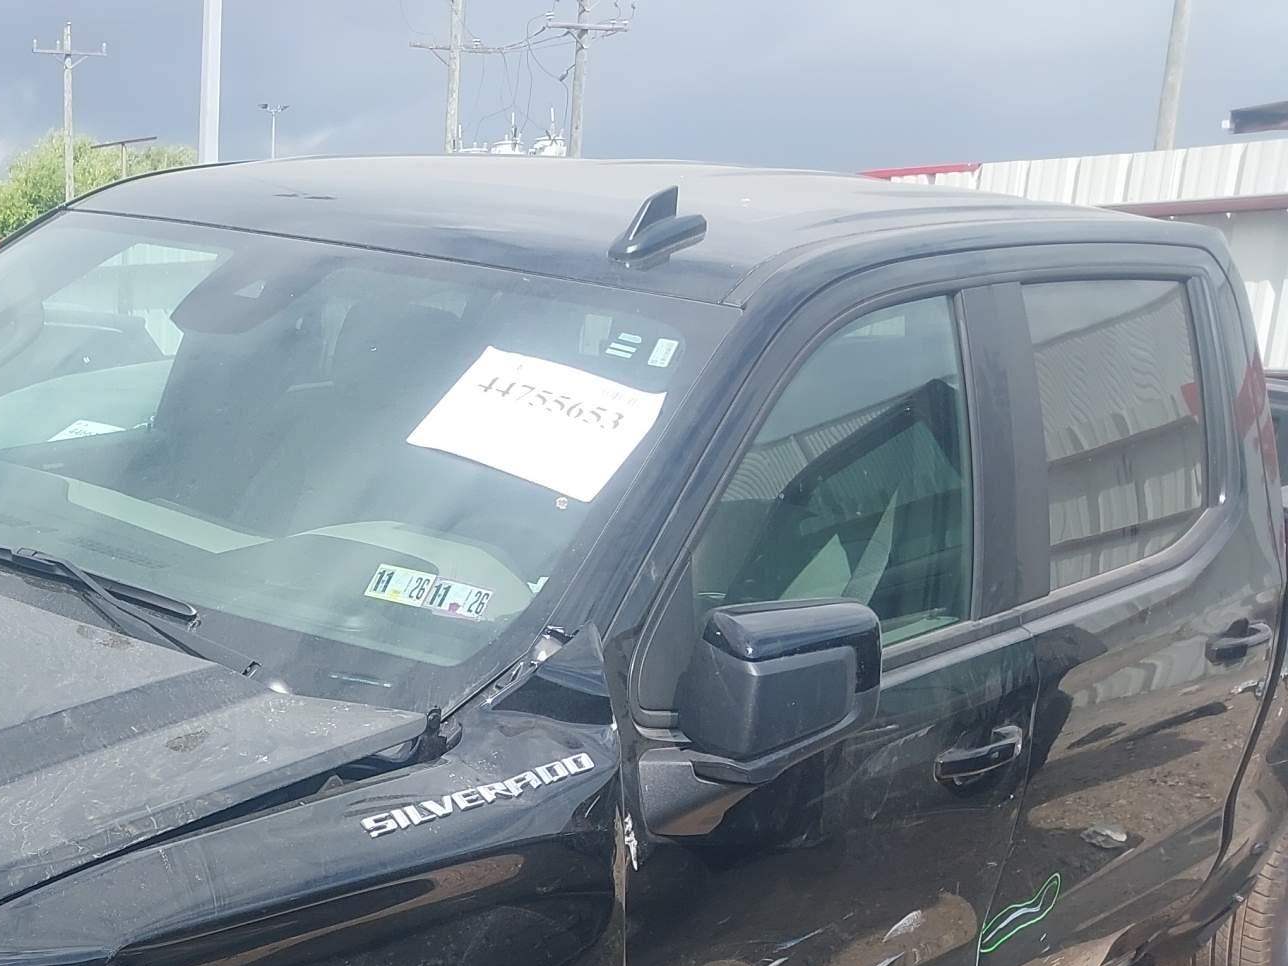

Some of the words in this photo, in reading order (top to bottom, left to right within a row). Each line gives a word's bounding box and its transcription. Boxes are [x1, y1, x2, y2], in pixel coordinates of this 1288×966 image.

[477, 376, 625, 430] 44755653
[373, 569, 395, 593] 11
[408, 577, 430, 600] 26
[429, 583, 452, 607] 11
[467, 591, 490, 615] 26
[360, 752, 595, 839] SILVERADO
